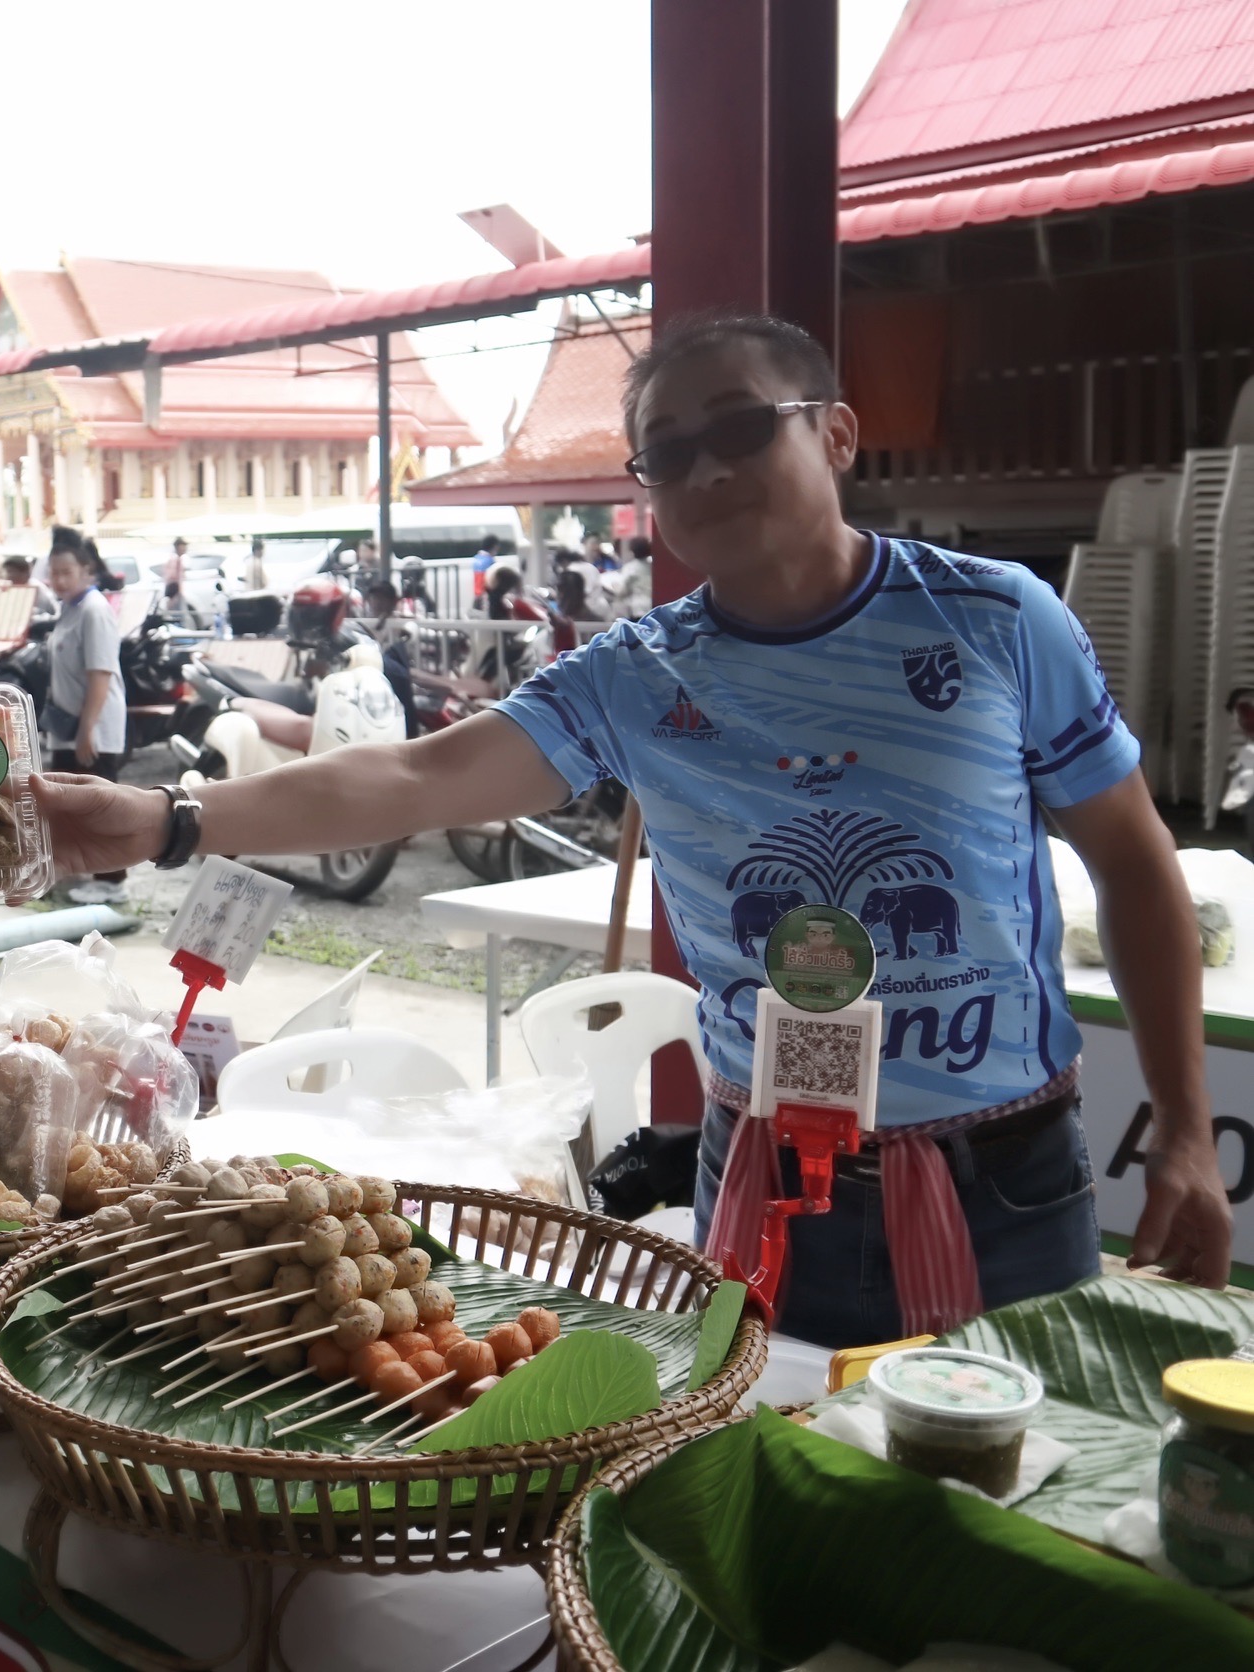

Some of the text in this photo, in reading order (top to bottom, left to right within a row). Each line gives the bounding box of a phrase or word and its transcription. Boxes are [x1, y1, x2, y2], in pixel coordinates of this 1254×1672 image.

[900, 641, 955, 659] THAILAND
[669, 729, 722, 741] SPORT
[604, 1155, 649, 1184] TOYOTA
